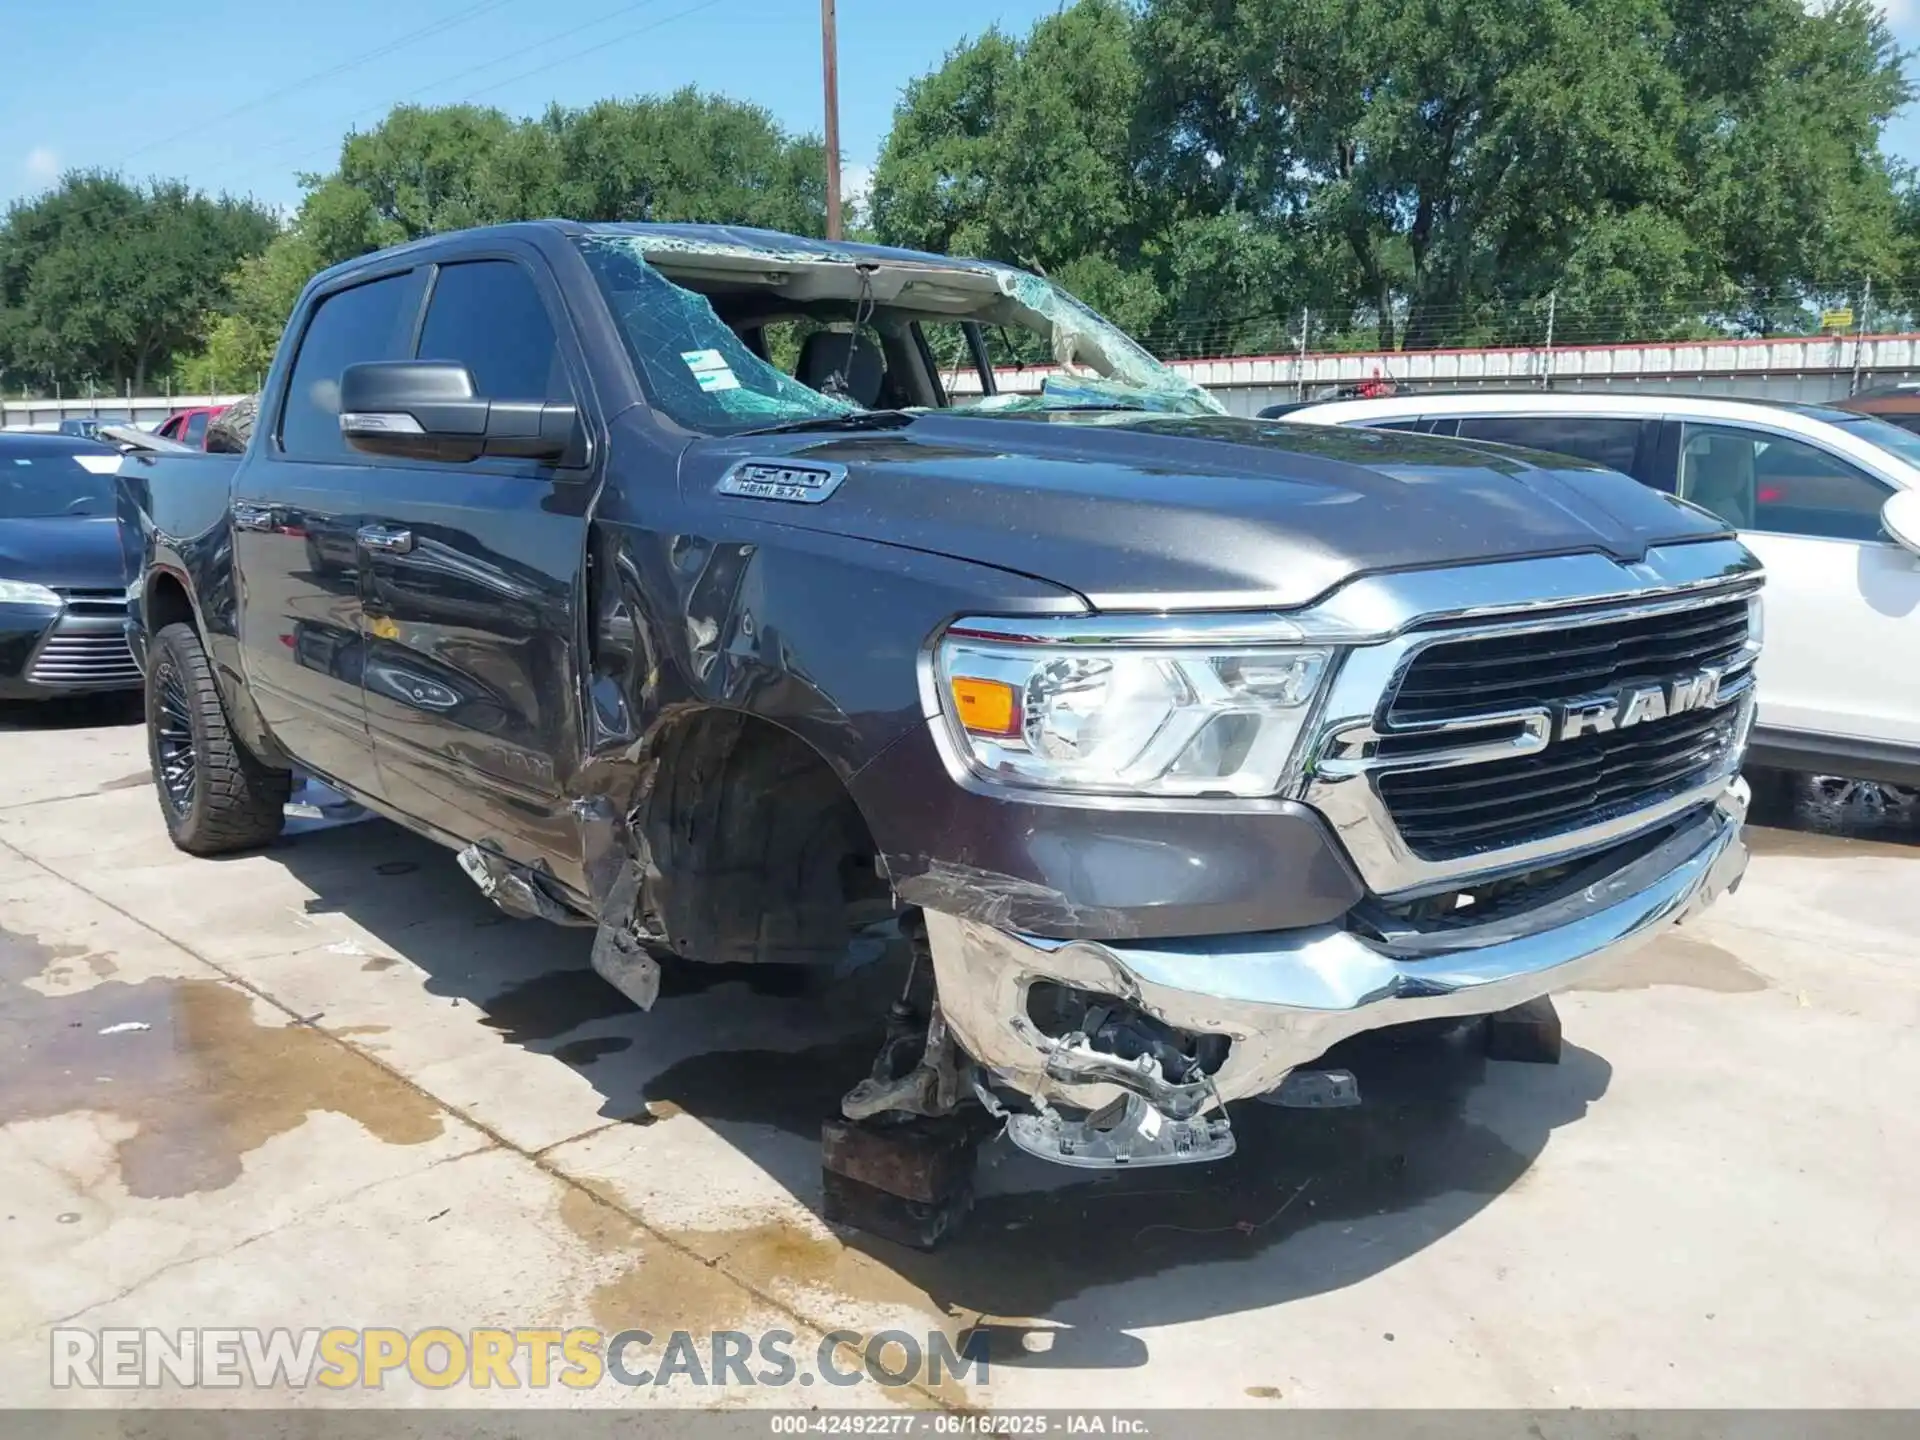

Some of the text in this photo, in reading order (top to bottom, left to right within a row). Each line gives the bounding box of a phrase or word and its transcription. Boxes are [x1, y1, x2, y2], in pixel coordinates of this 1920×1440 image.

[734, 465, 829, 488] 1500
[739, 482, 808, 498] HEMI 5.7L
[1560, 667, 1722, 741] RAM
